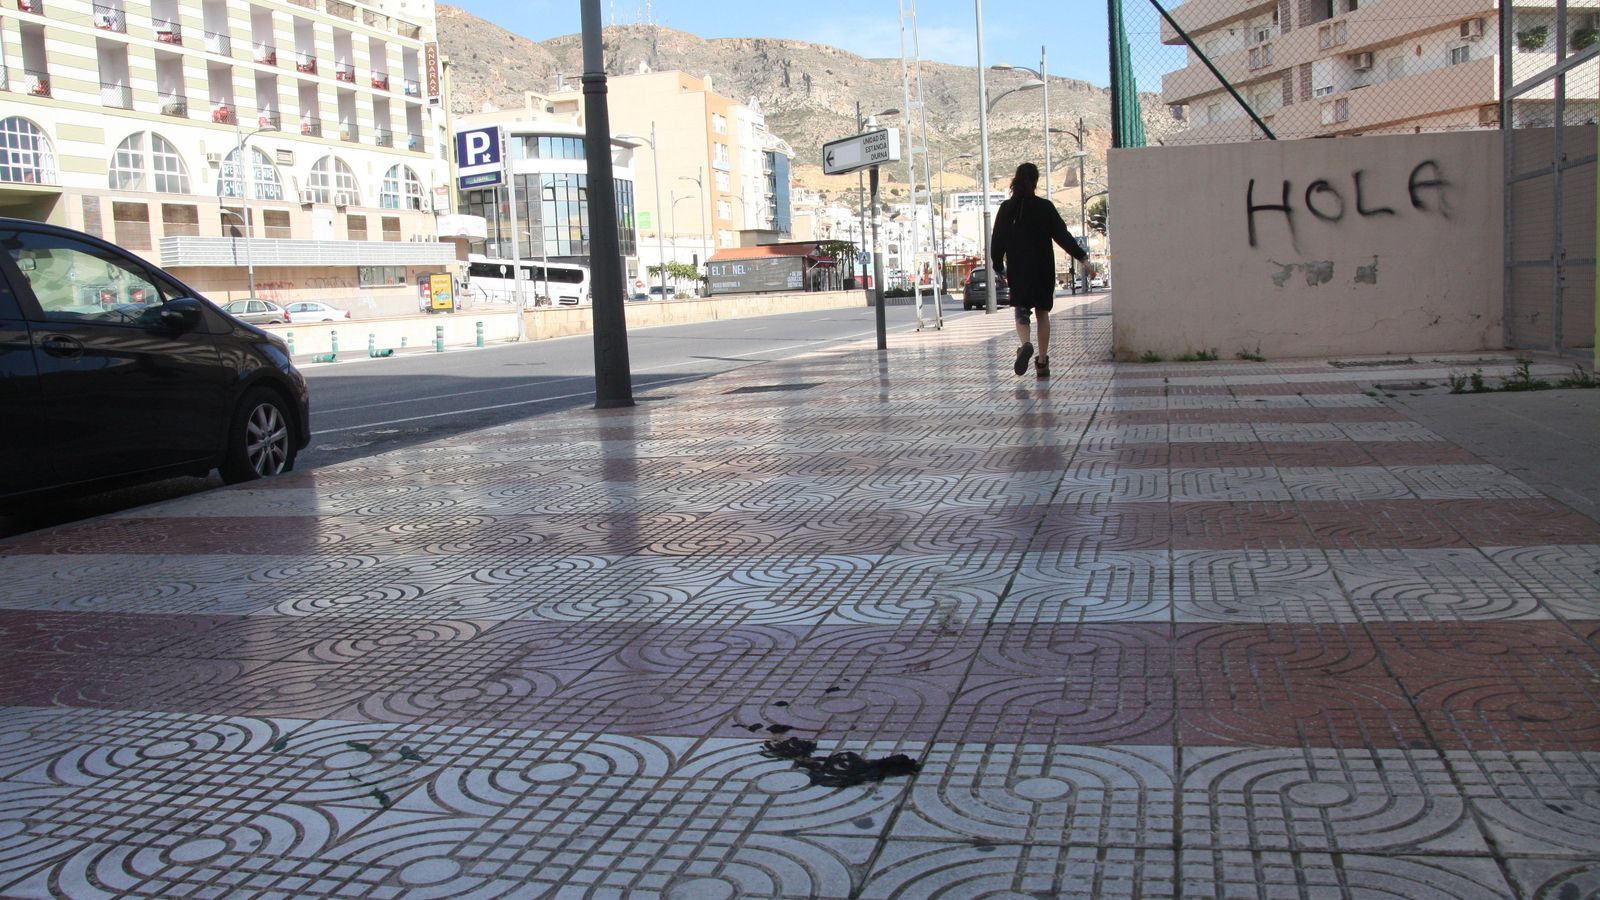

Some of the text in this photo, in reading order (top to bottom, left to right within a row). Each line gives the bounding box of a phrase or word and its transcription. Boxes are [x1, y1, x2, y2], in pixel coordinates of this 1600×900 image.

[427, 47, 437, 93] ANDARAX
[862, 133, 886, 145] UNIDAD DE
[465, 131, 491, 166] P
[865, 142, 887, 153] ESTANCIA
[870, 151, 887, 161] DIURNA
[1246, 160, 1452, 254] HOLA
[711, 266, 721, 276] EL
